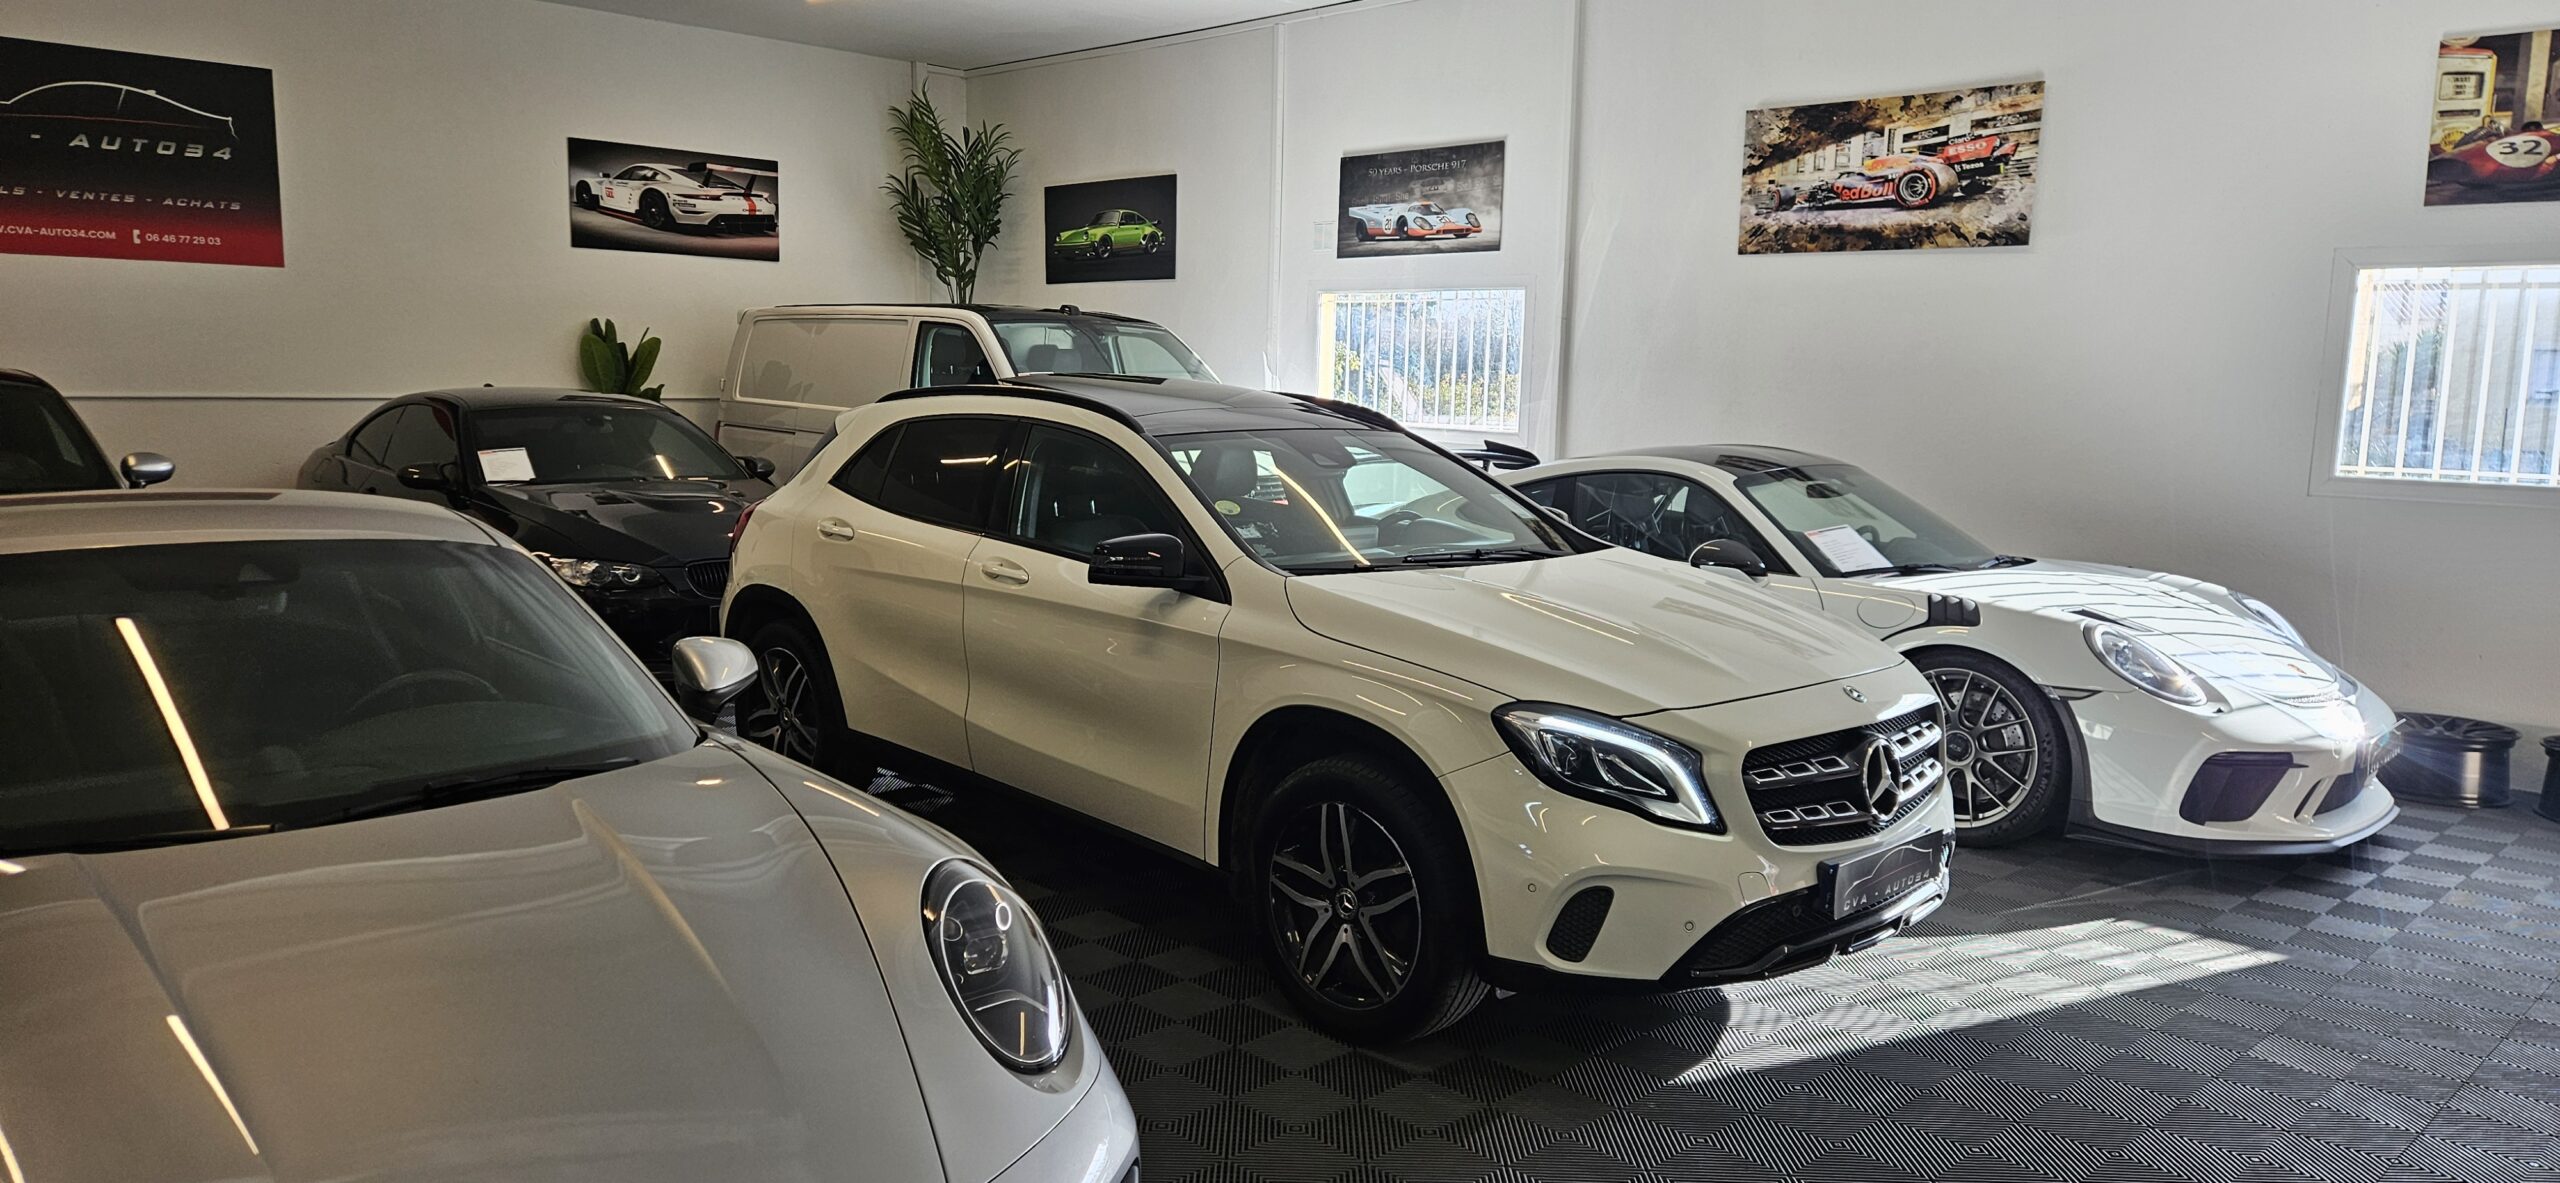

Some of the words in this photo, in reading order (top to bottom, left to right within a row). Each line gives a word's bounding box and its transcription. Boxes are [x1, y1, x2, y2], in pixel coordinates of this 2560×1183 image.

[69, 133, 232, 160] AUTO34
[2498, 140, 2543, 155] 32
[1379, 166, 1402, 176] YEARS
[1410, 162, 1449, 173] PORSCHE
[1451, 160, 1467, 169] 917
[56, 190, 135, 203] VENTES
[162, 198, 241, 210] ACHATS
[145, 233, 160, 242] 06
[179, 235, 191, 244] 77
[207, 237, 222, 246] 03
[1843, 893, 1867, 911] CVA
[1884, 869, 1931, 895] AUTO34
